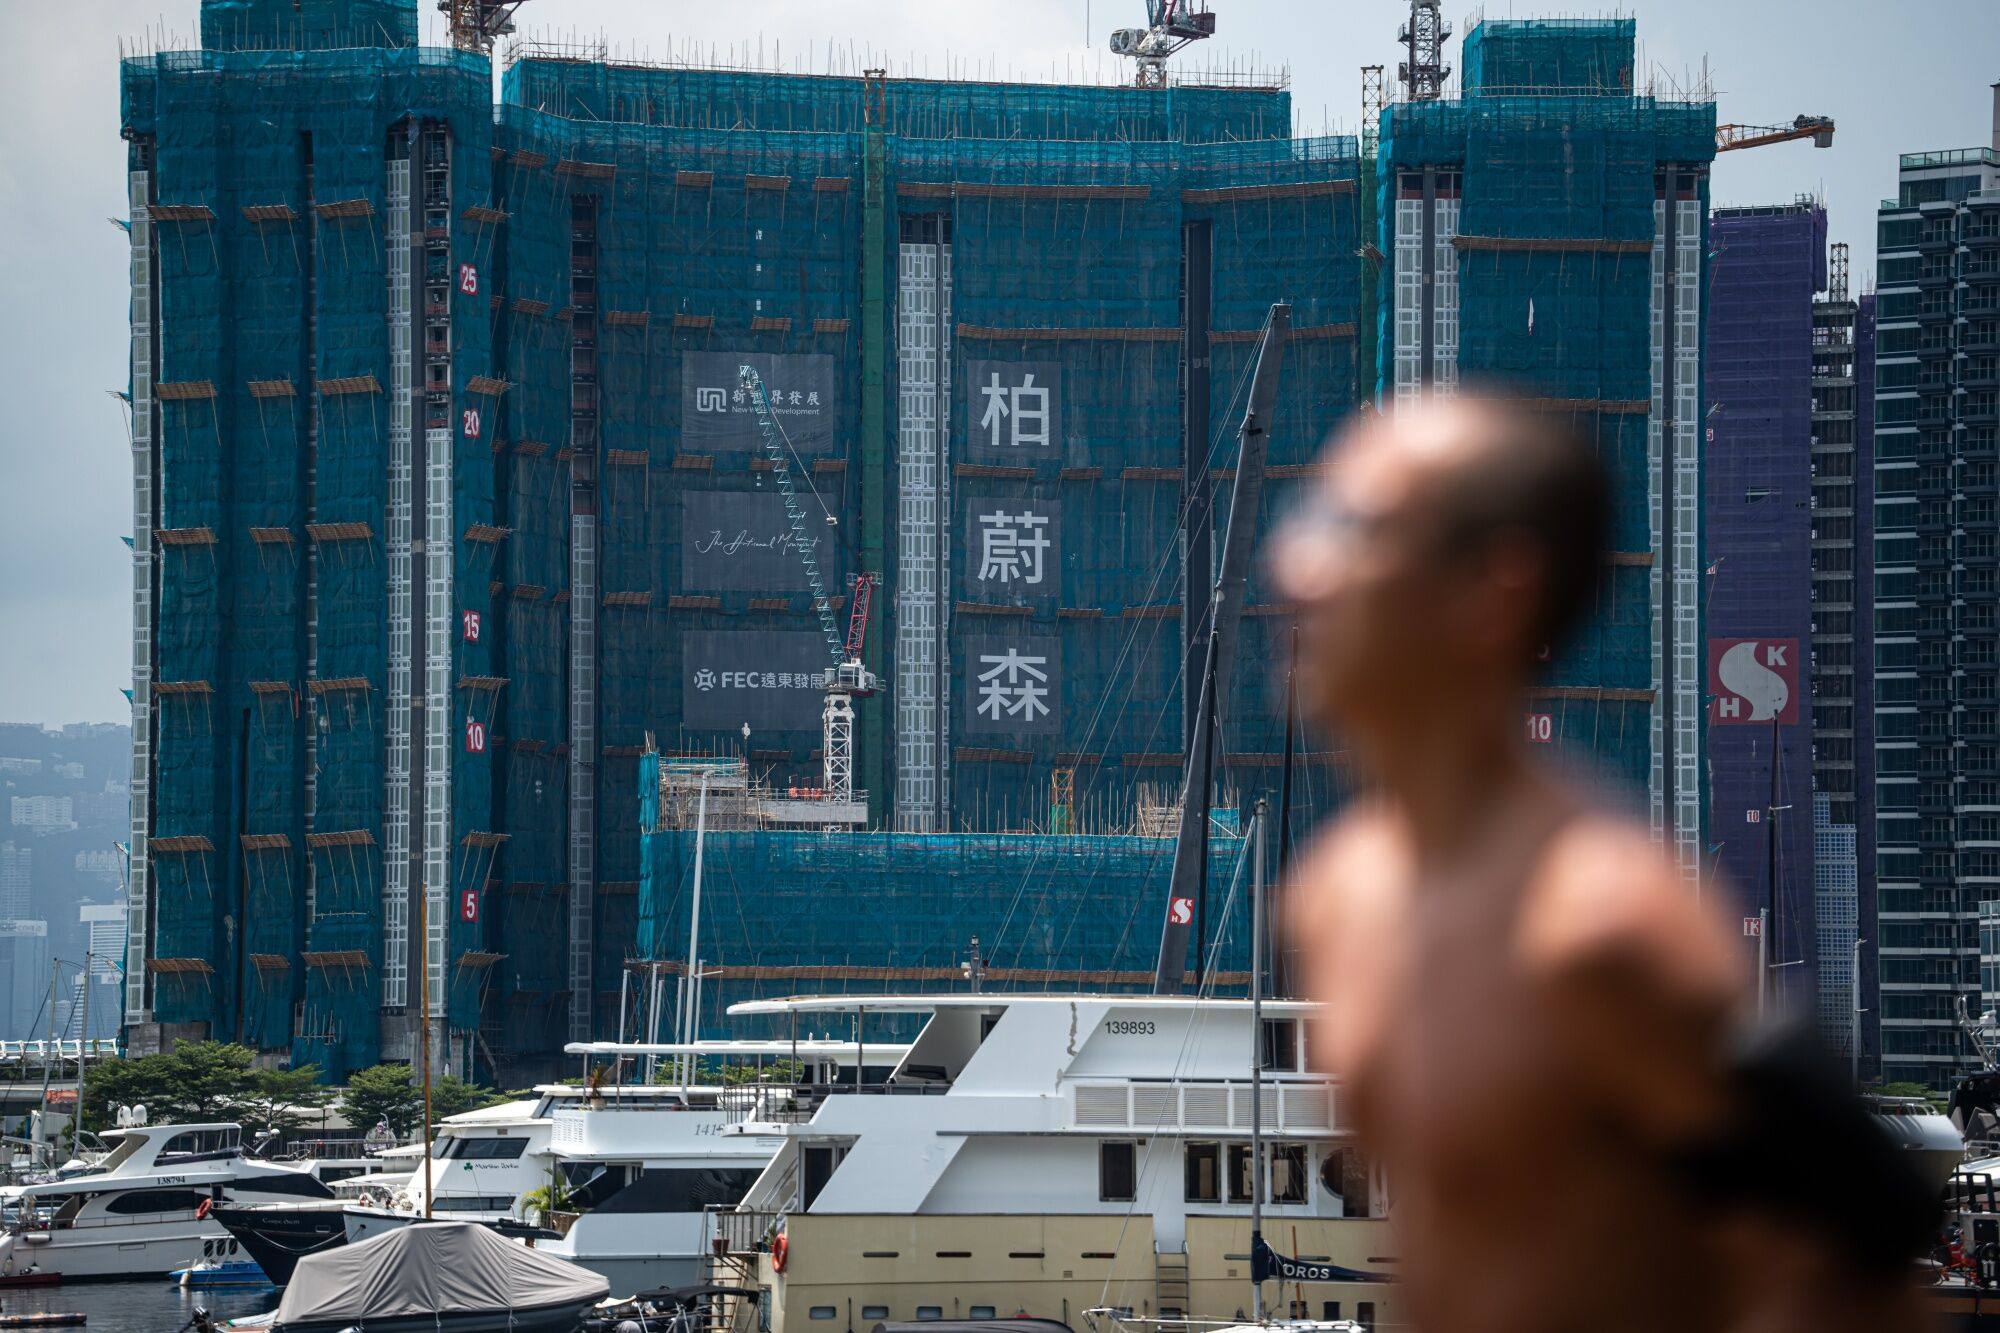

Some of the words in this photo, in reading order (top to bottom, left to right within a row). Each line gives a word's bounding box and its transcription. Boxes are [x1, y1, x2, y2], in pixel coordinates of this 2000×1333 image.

[462, 265, 477, 293] 25
[731, 389, 820, 406] 新界發展
[772, 406, 820, 415] Development
[463, 410, 479, 436] 20
[464, 613, 479, 638] 15
[721, 671, 759, 688] FEC
[761, 672, 825, 689] 遠東發展
[1527, 715, 1551, 740] 10
[468, 725, 484, 750] 10
[1747, 810, 1759, 822] 10
[466, 893, 475, 919] 5
[1744, 918, 1760, 935] T3
[1104, 1021, 1155, 1035] 139893
[156, 1175, 186, 1185] 138794
[1283, 1263, 1330, 1279] OROS
